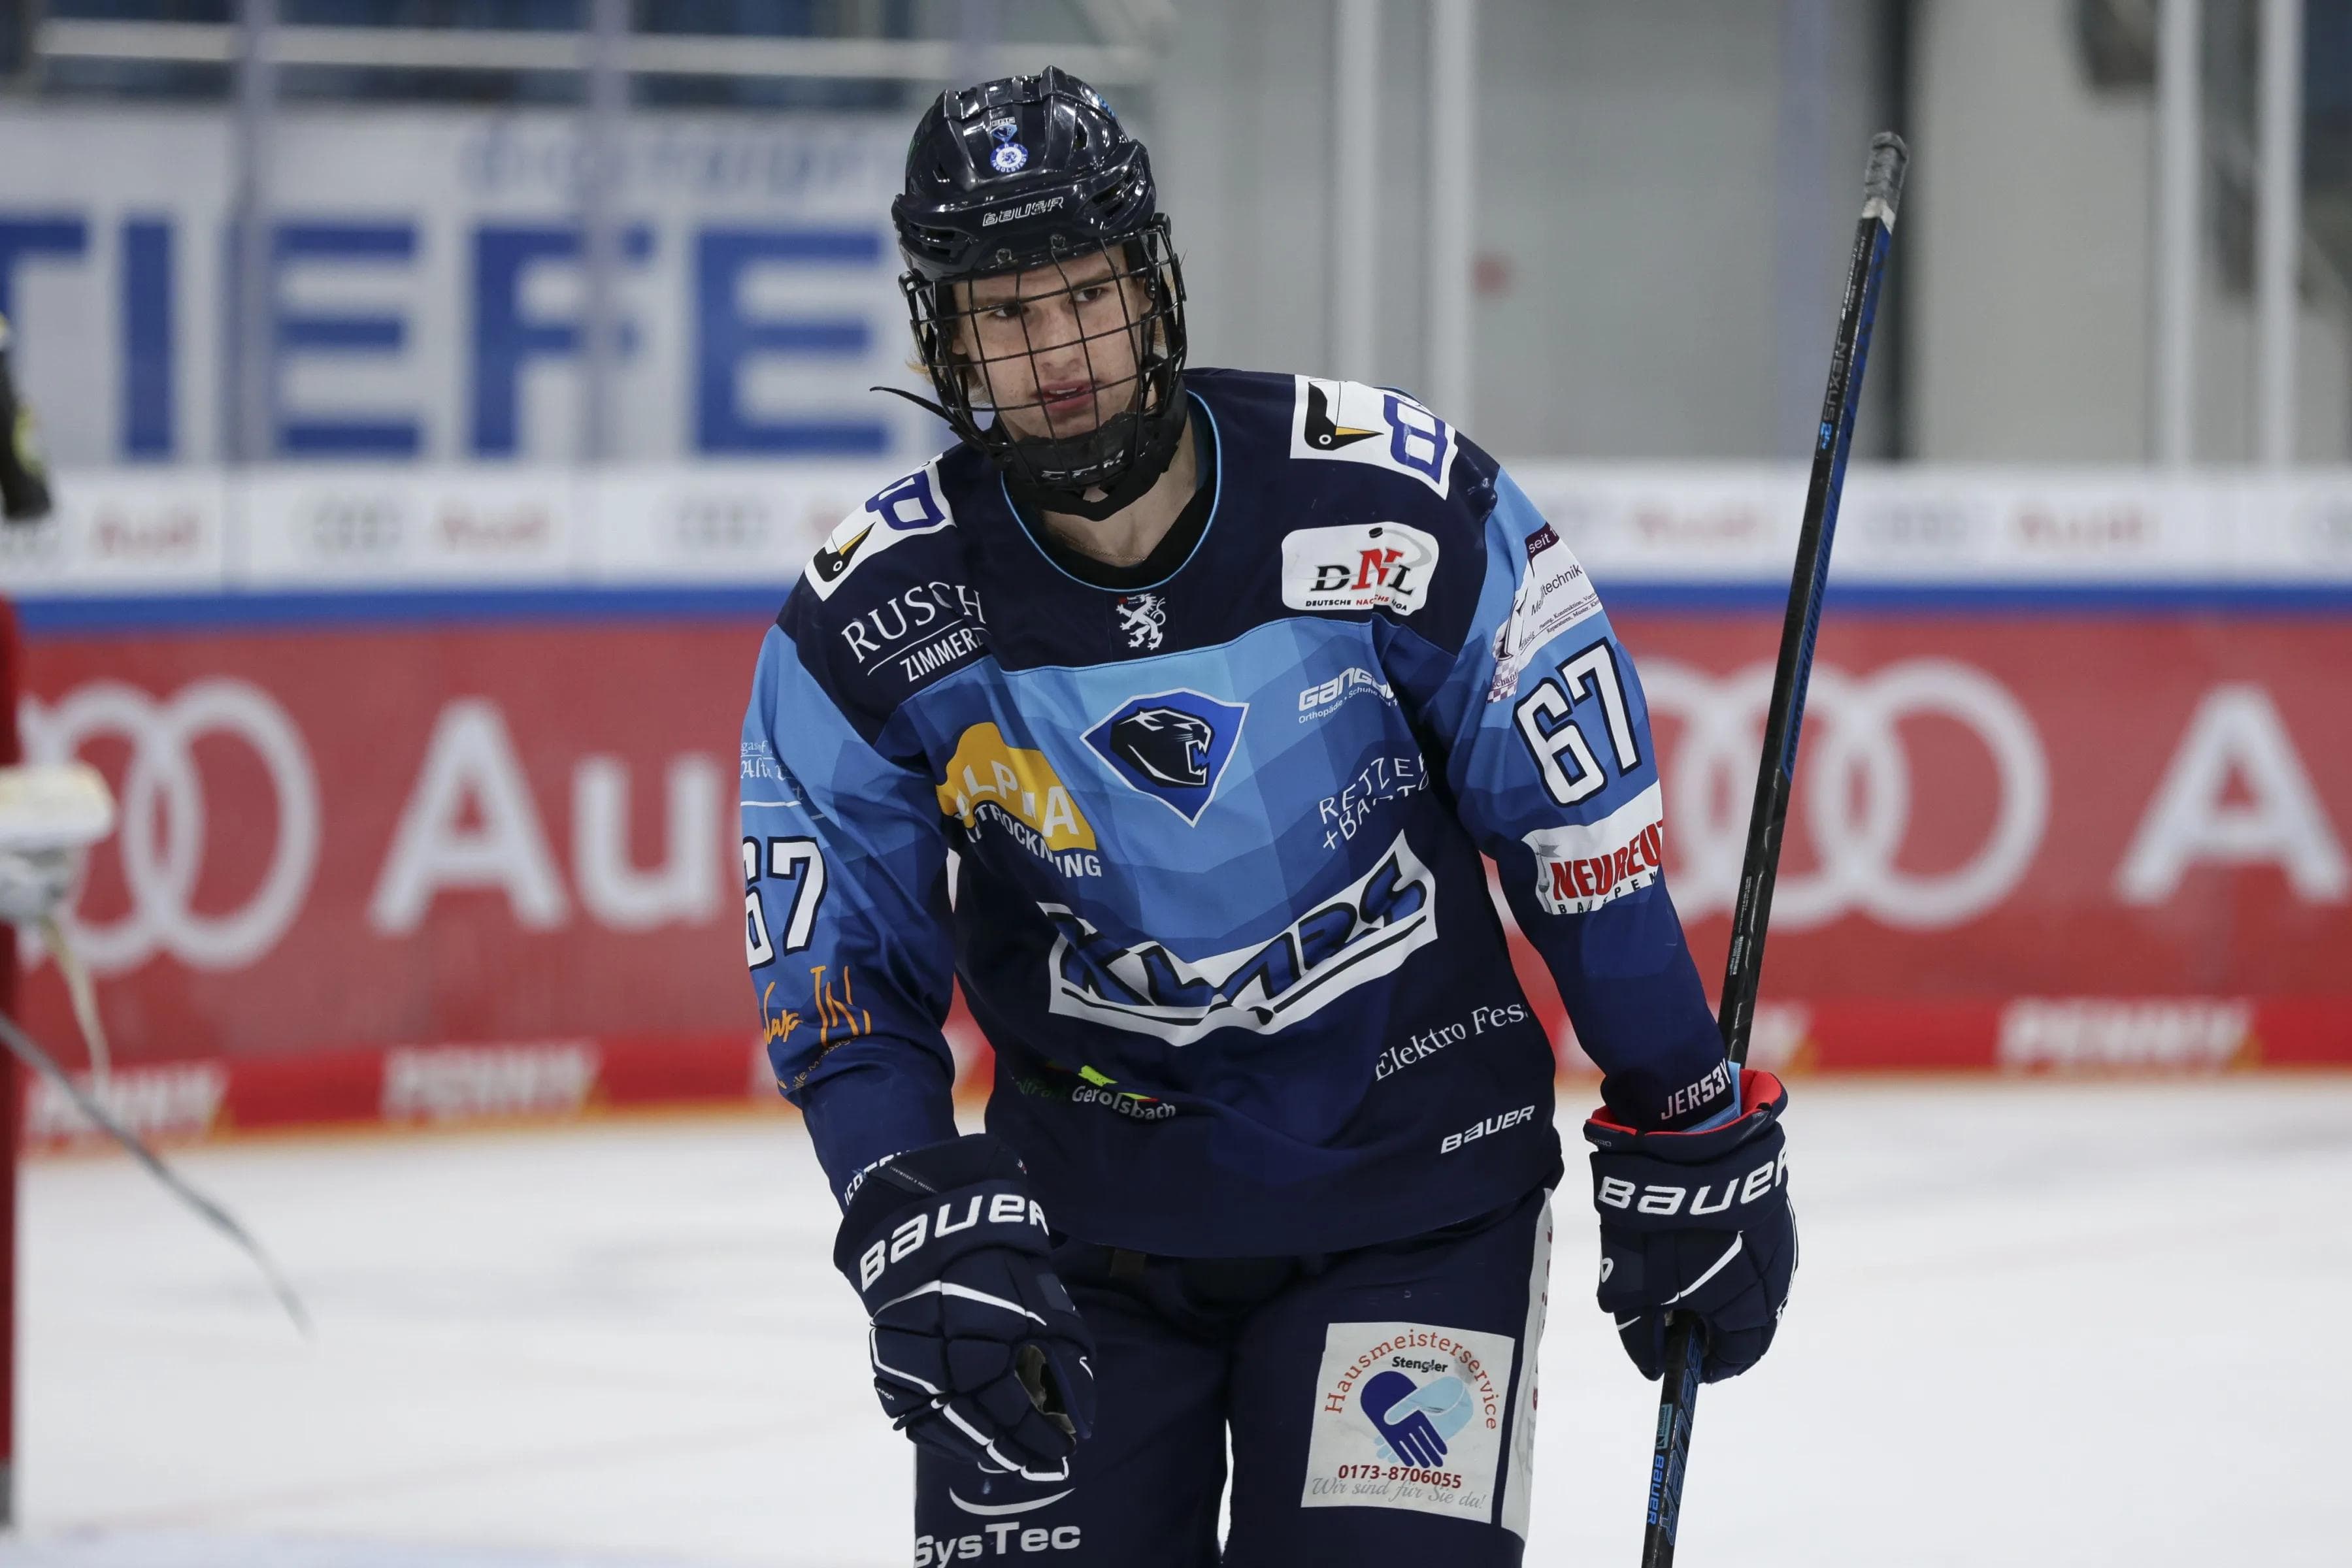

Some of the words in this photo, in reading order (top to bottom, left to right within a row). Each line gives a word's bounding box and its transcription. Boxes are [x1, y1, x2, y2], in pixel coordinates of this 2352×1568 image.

[982, 196, 1064, 227] BAUER
[1529, 534, 1551, 553] seit
[1310, 547, 1414, 595] DNL
[1299, 699, 1343, 723] Orthopädie
[1348, 687, 1378, 698] Schuhe
[1514, 638, 1642, 808] 67
[1375, 1023, 1466, 1081] Elektro
[1471, 1004, 1529, 1035] Fes
[1072, 1085, 1177, 1120] Gerolsbach
[1440, 1105, 1536, 1154] BAUER
[1597, 1143, 1789, 1215] BAUER
[859, 1194, 1050, 1293] BAUER
[1325, 1329, 1497, 1429] Hausmeisterservice
[1392, 1356, 1448, 1373] Stengler
[1312, 1477, 1347, 1495] Wir
[1351, 1478, 1390, 1495] sind
[1388, 1479, 1422, 1502] für
[1428, 1482, 1454, 1504] Sie
[1458, 1491, 1486, 1509] da!
[1338, 1465, 1462, 1489] 0173-8706055
[1646, 1454, 1665, 1526] BAUER
[915, 1522, 1081, 1568] SysTec
